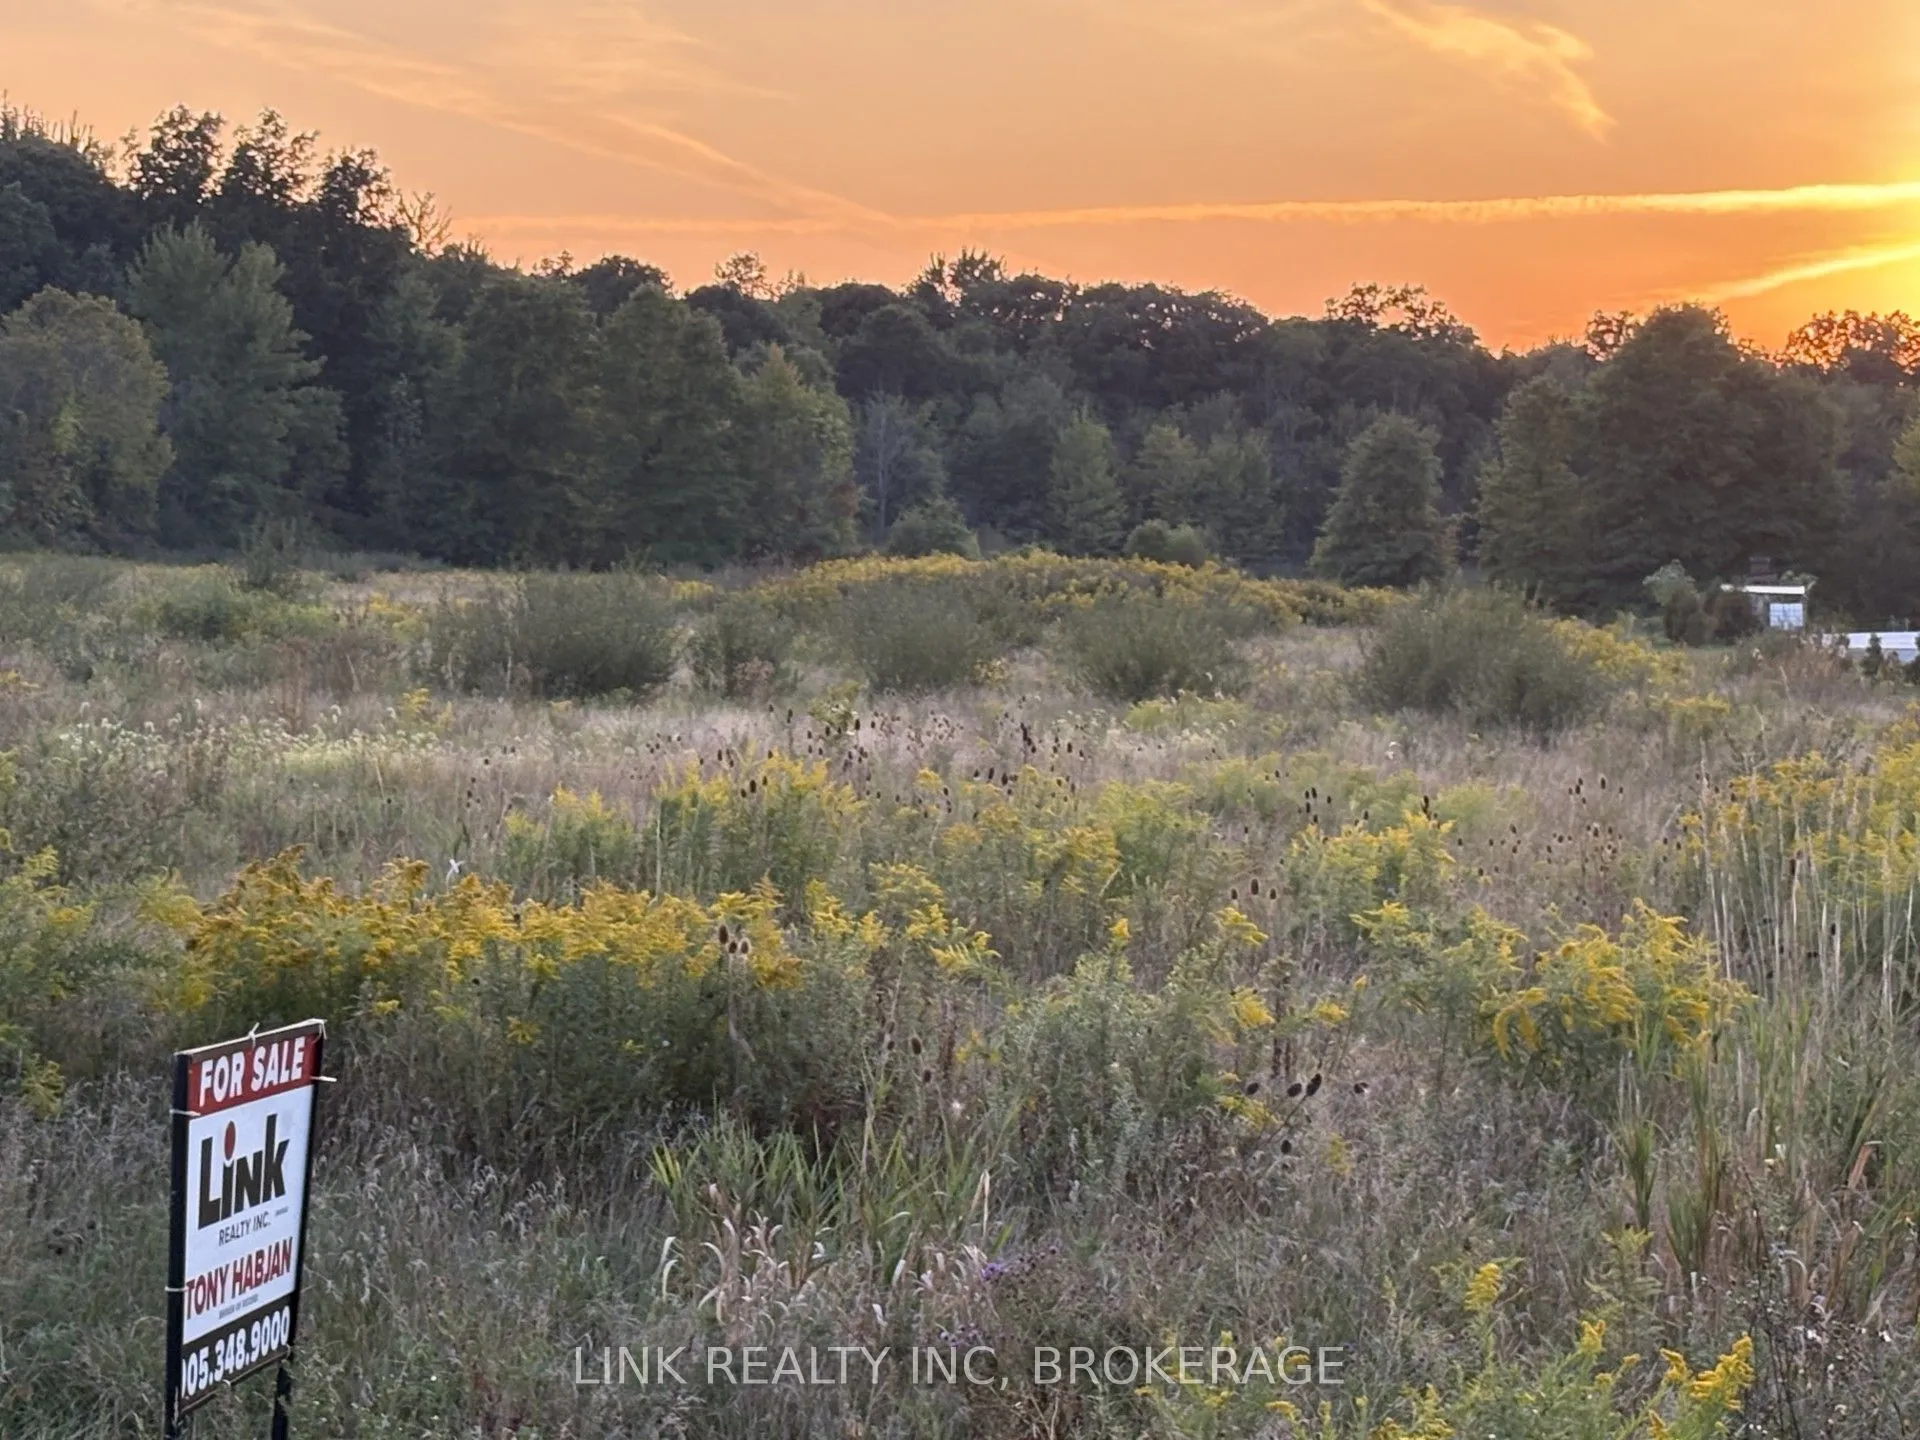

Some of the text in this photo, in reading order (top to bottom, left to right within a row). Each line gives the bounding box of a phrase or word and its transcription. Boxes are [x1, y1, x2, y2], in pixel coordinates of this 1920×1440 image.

[199, 1035, 306, 1108] FOR SALE
[218, 1211, 271, 1247] REALTY INC.
[186, 1263, 230, 1320] TONY
[232, 1236, 294, 1299] HABJAN
